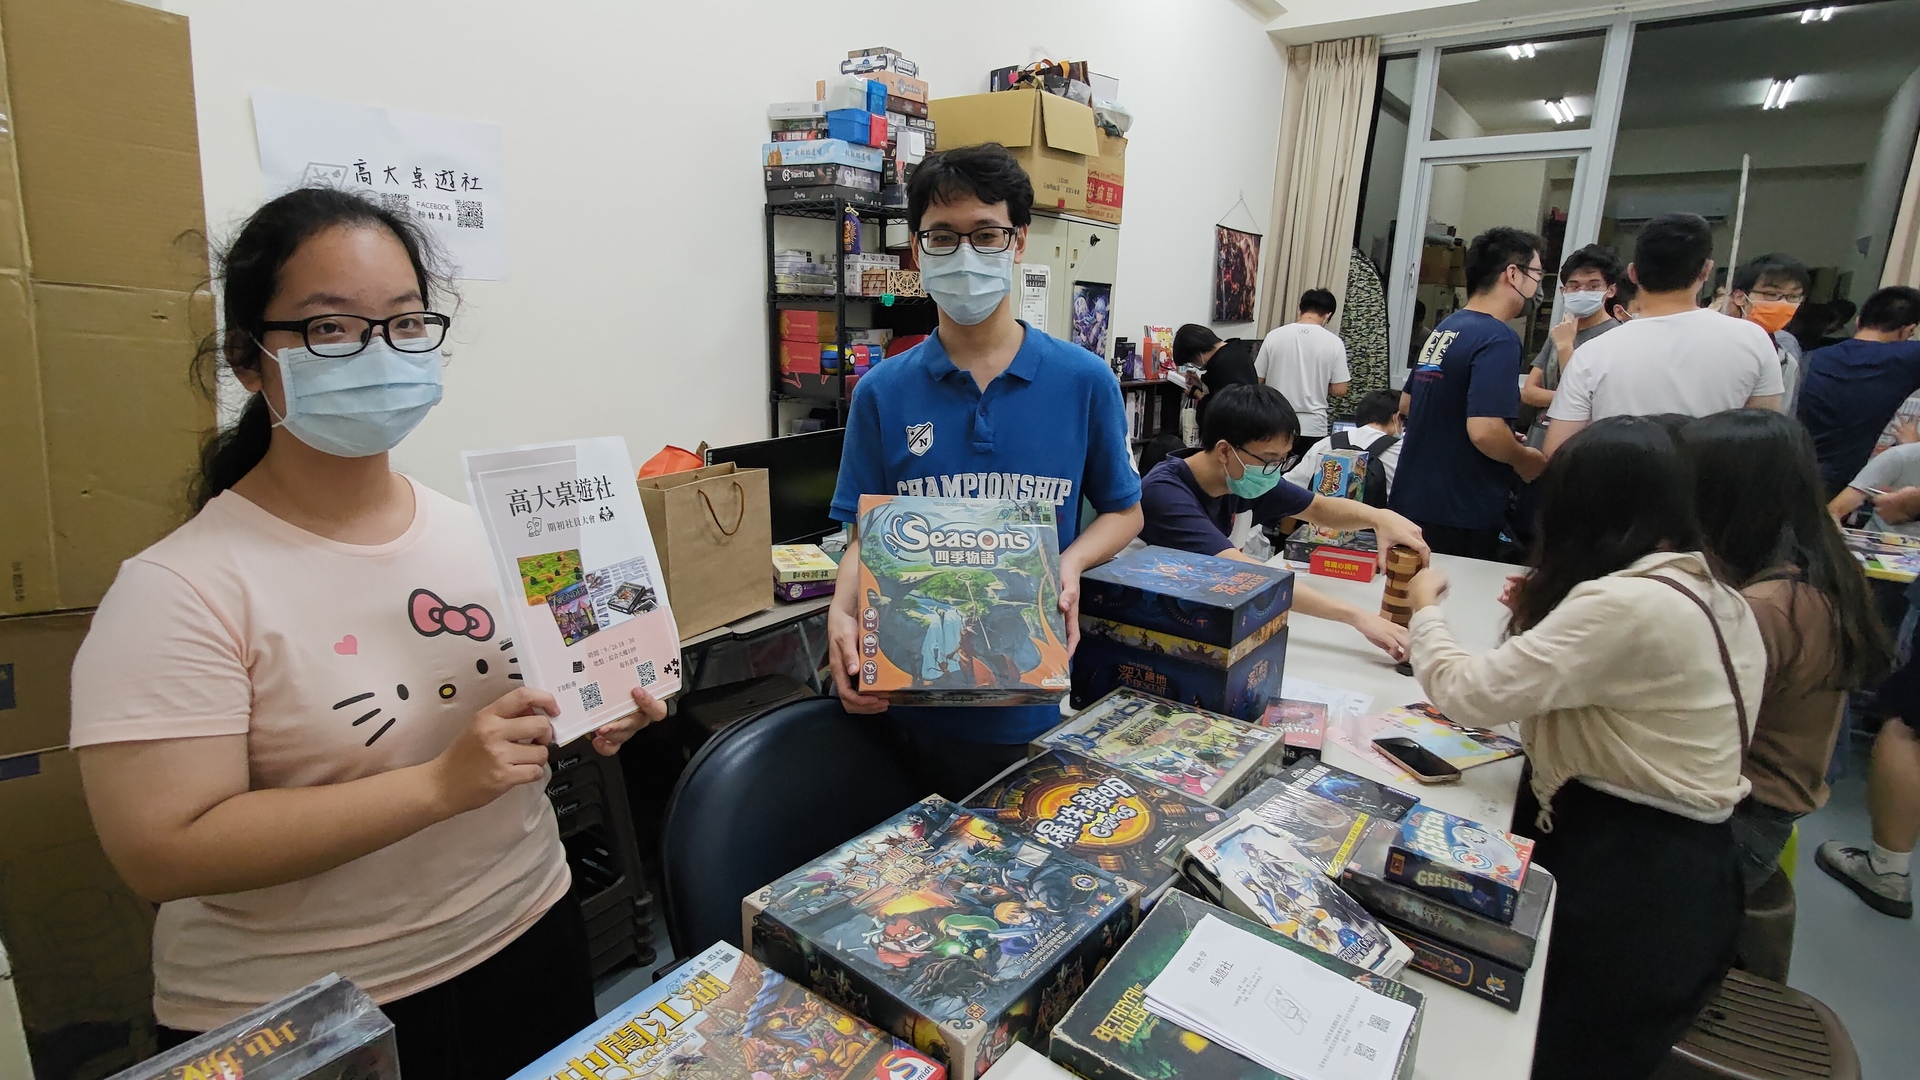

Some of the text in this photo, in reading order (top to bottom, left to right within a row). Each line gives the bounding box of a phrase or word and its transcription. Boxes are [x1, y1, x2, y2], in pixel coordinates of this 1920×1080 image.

[352, 158, 483, 192] 高大桌遊社
[416, 200, 450, 211] FACEBOOK
[919, 438, 928, 447] N
[505, 475, 615, 517] 高大桌遊社
[897, 472, 1073, 505] CHAMPIONSHIP
[887, 513, 1031, 552] Seasons
[935, 550, 995, 565] 四季物語
[1209, 960, 1235, 988] 桌遊社
[582, 1010, 632, 1045] Wolfgang Warsch
[1091, 987, 1144, 1043] BETRAYAL
[1114, 1002, 1150, 1044] HOUSE
[602, 1028, 687, 1080] Quacks
